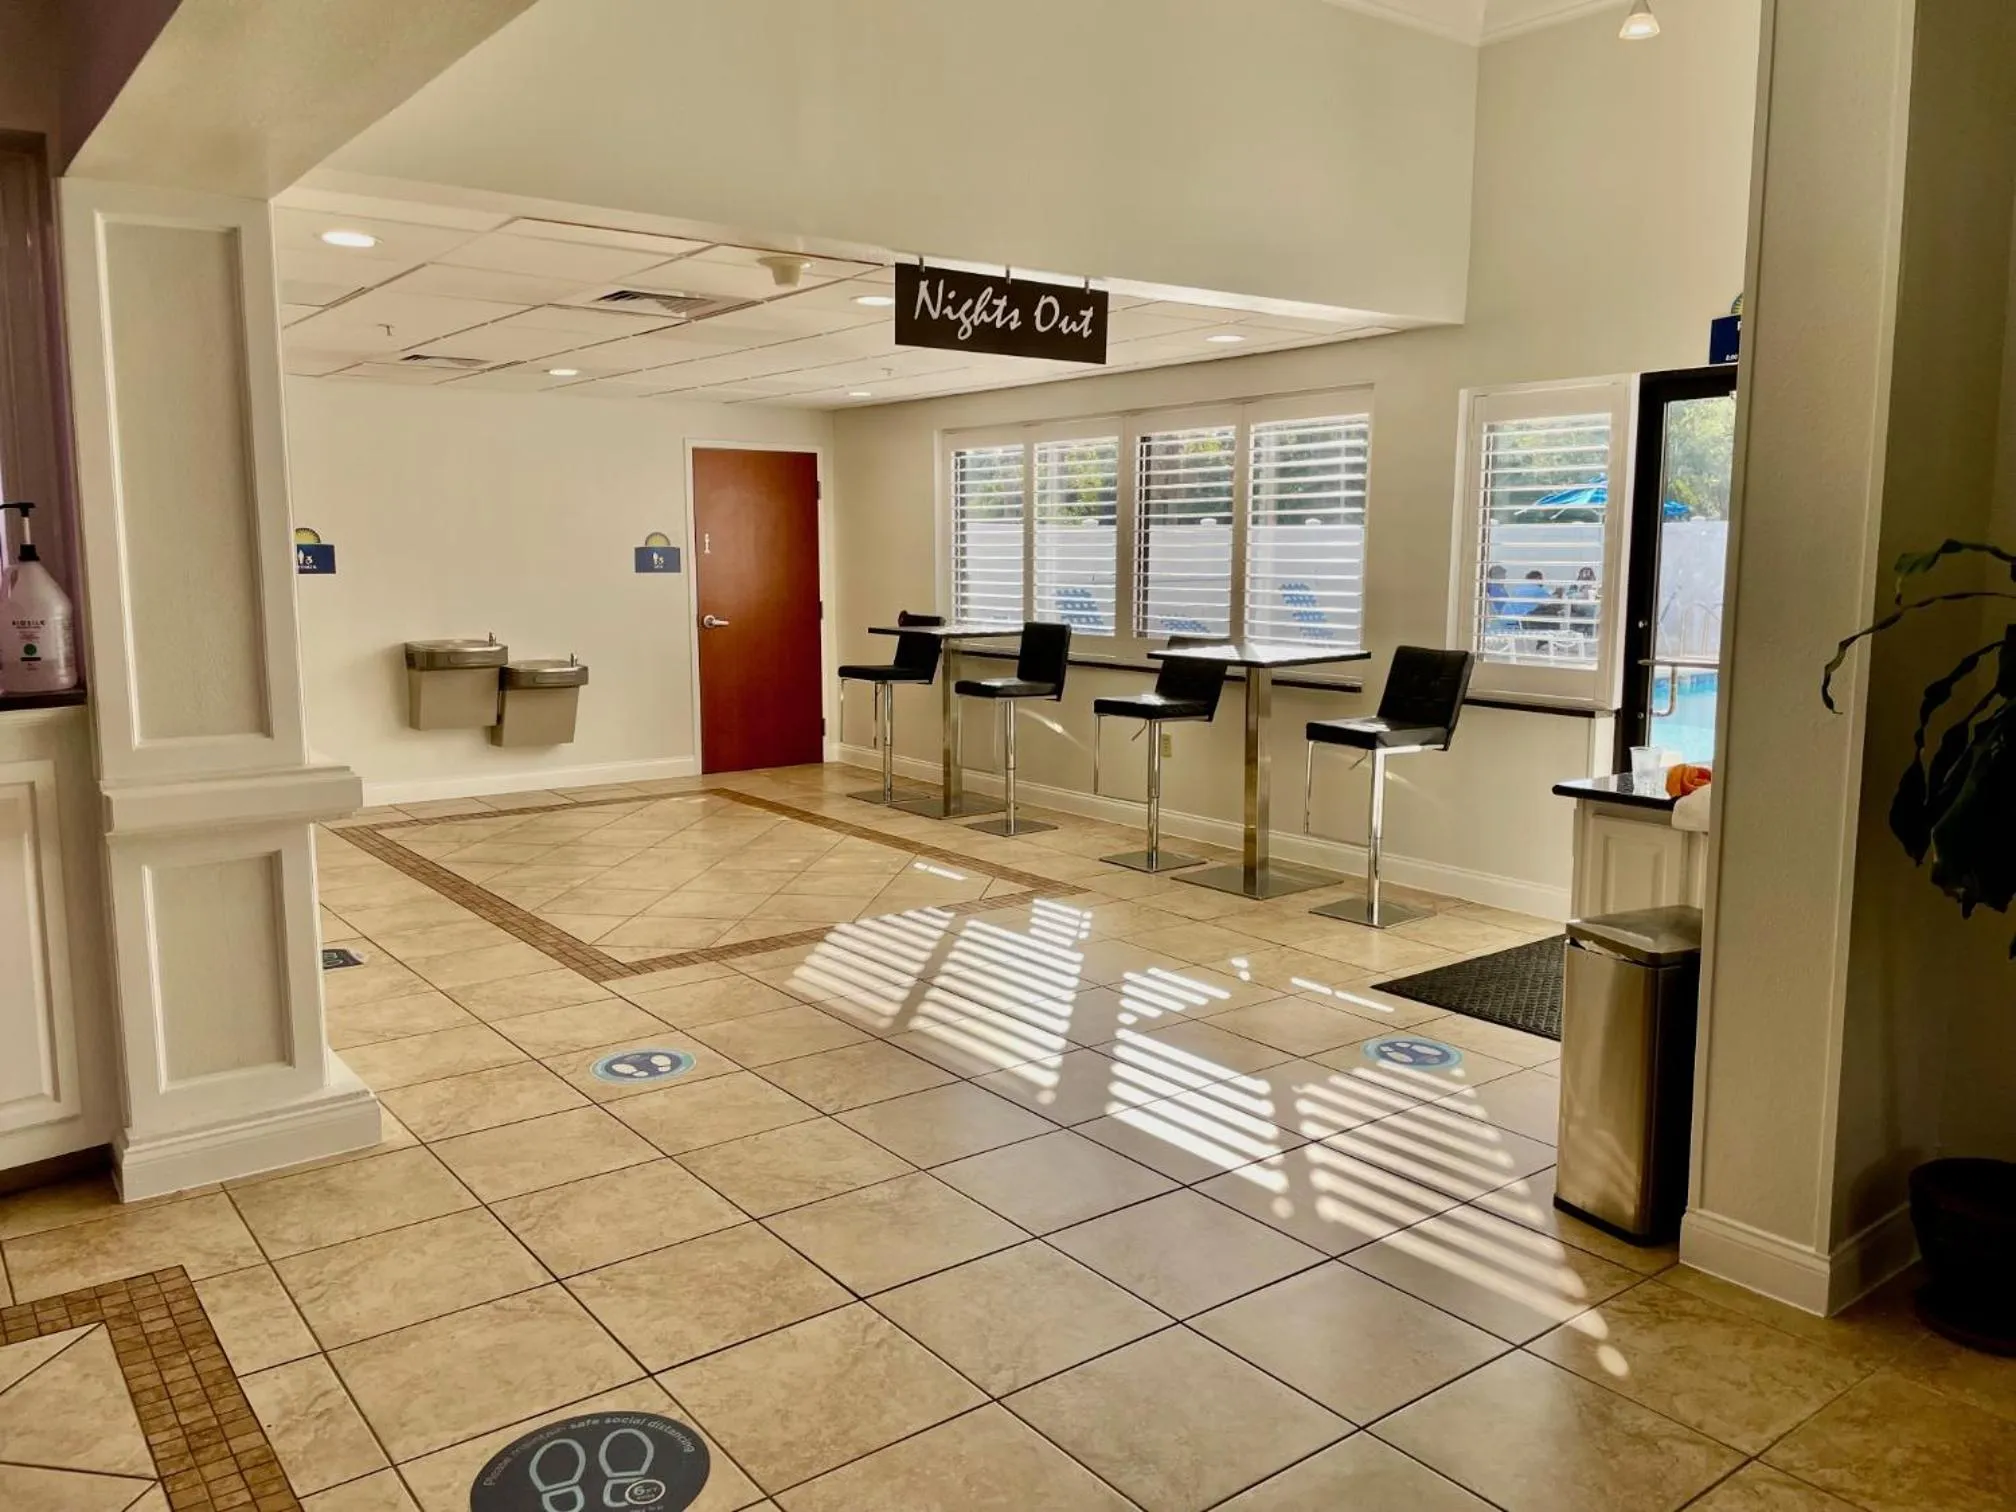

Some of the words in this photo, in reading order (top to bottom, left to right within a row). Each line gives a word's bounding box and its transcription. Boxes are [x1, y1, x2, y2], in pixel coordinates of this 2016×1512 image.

[914, 279, 1022, 340] Nights
[1034, 294, 1094, 338] Out
[569, 1418, 600, 1430] safe
[604, 1416, 647, 1426] social
[647, 1419, 695, 1453] distancing
